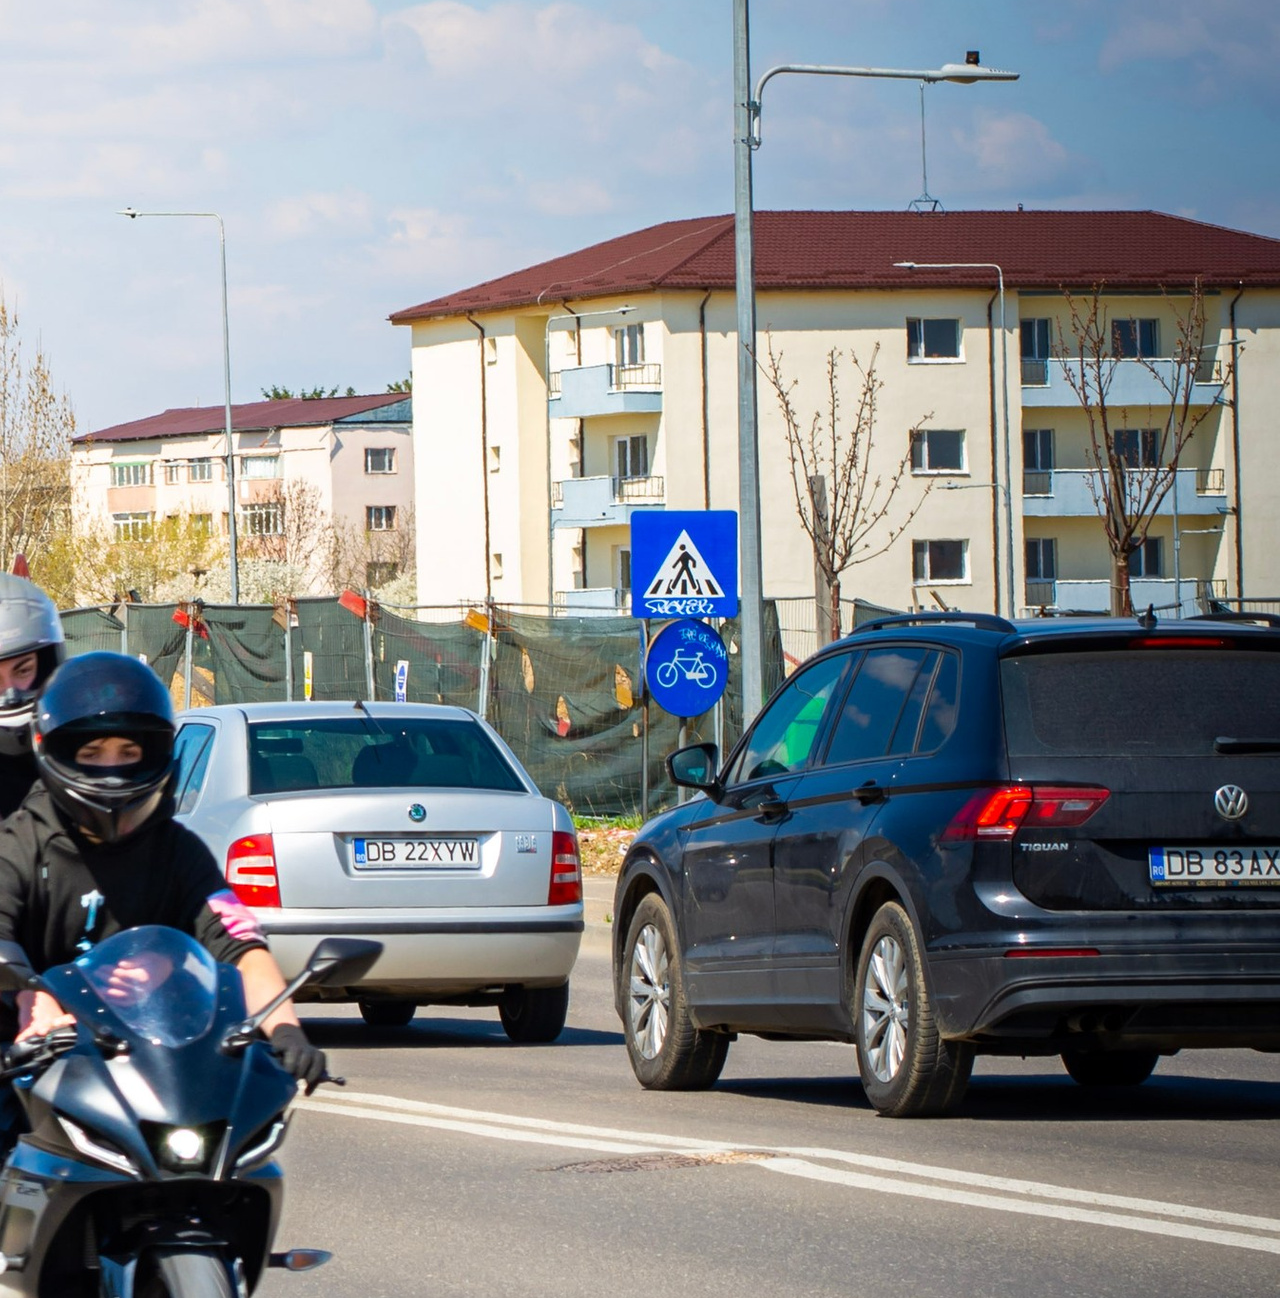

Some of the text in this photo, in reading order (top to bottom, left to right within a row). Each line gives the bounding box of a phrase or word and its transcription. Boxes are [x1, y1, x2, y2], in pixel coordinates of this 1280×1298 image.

[366, 842, 396, 862] DB
[1020, 842, 1069, 851] TIGUAN
[1152, 865, 1164, 875] RO
[1166, 850, 1204, 876] DB
